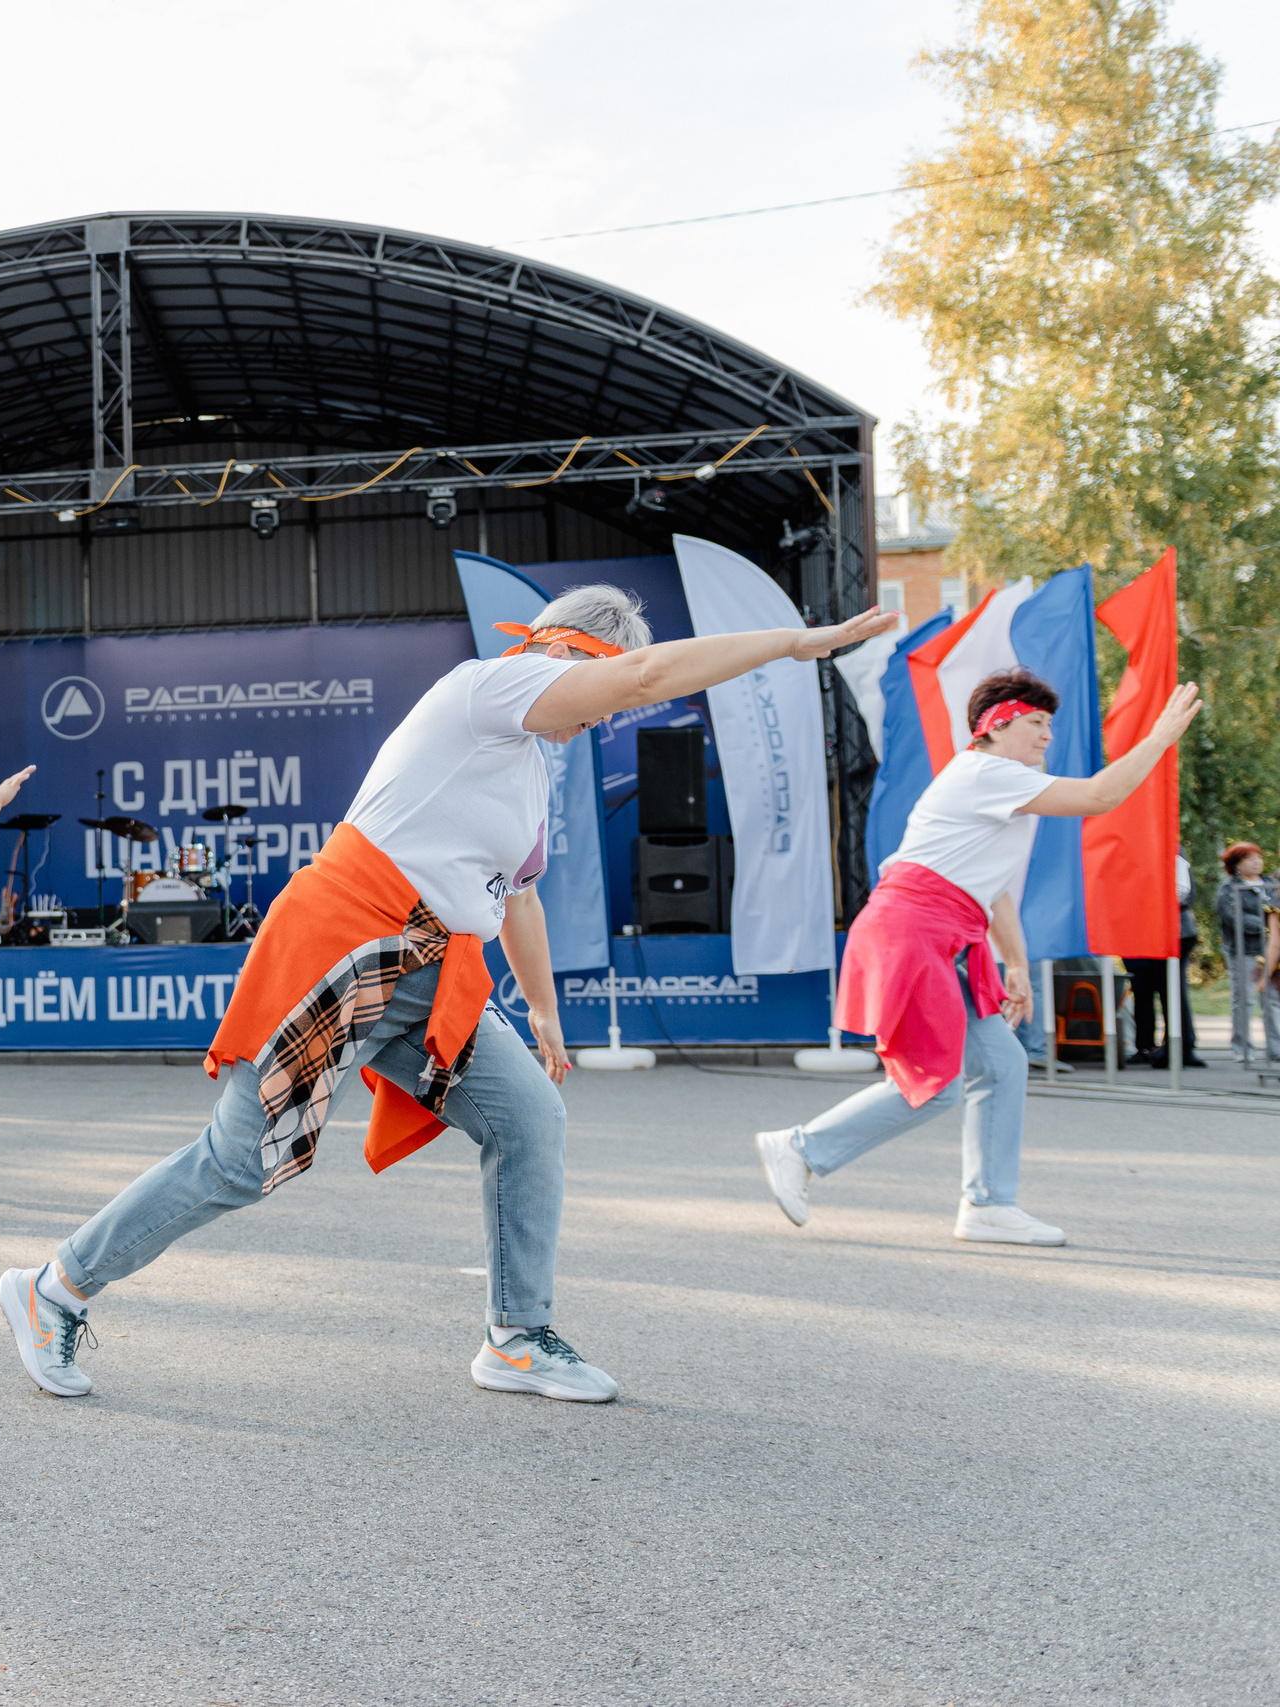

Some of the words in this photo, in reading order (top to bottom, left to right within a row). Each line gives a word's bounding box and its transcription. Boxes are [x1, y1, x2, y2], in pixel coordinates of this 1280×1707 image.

[125, 678, 373, 712] РАСПАДСКАЯ
[125, 710, 238, 724] УГОЛЬНАЯ
[256, 706, 375, 721] КОМПАНИЯ
[112, 761, 145, 811] С
[159, 750, 301, 816] ДНЁМ
[107, 967, 242, 1021] ШАХТ
[564, 975, 758, 997] РАСПАДСКАЯ
